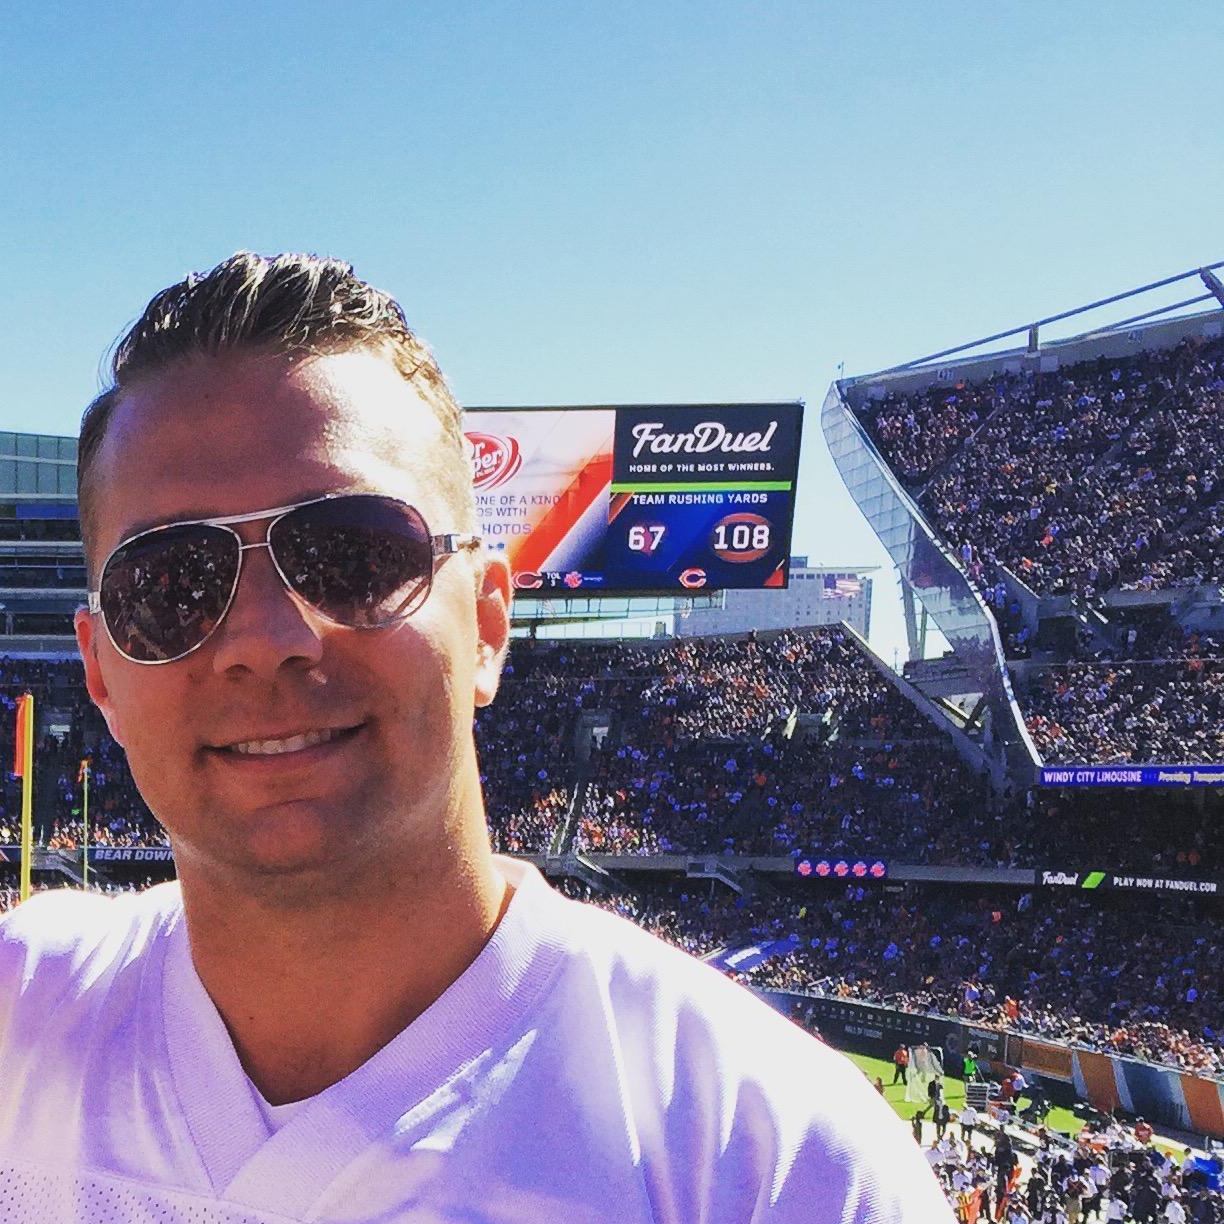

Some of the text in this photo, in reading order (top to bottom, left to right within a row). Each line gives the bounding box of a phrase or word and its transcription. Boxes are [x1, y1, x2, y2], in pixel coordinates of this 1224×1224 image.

[631, 420, 778, 459] FanDuel
[629, 462, 775, 473] HOME OF THE MOST WINNERS.
[500, 495, 516, 506] OF
[519, 495, 527, 506] A
[632, 493, 768, 505] TEAM RUSHING YARDS
[496, 507, 527, 518] WITH
[628, 526, 666, 551] 67
[713, 524, 770, 550] 108
[1043, 771, 1074, 783] WINDY
[1076, 771, 1096, 783] CITY
[1096, 771, 1143, 783] LIMOUSINE
[94, 849, 132, 861] BEAR
[1042, 871, 1079, 886] FanDuel
[1113, 876, 1217, 893] PLAY NOW AT FANDUEL.COM
